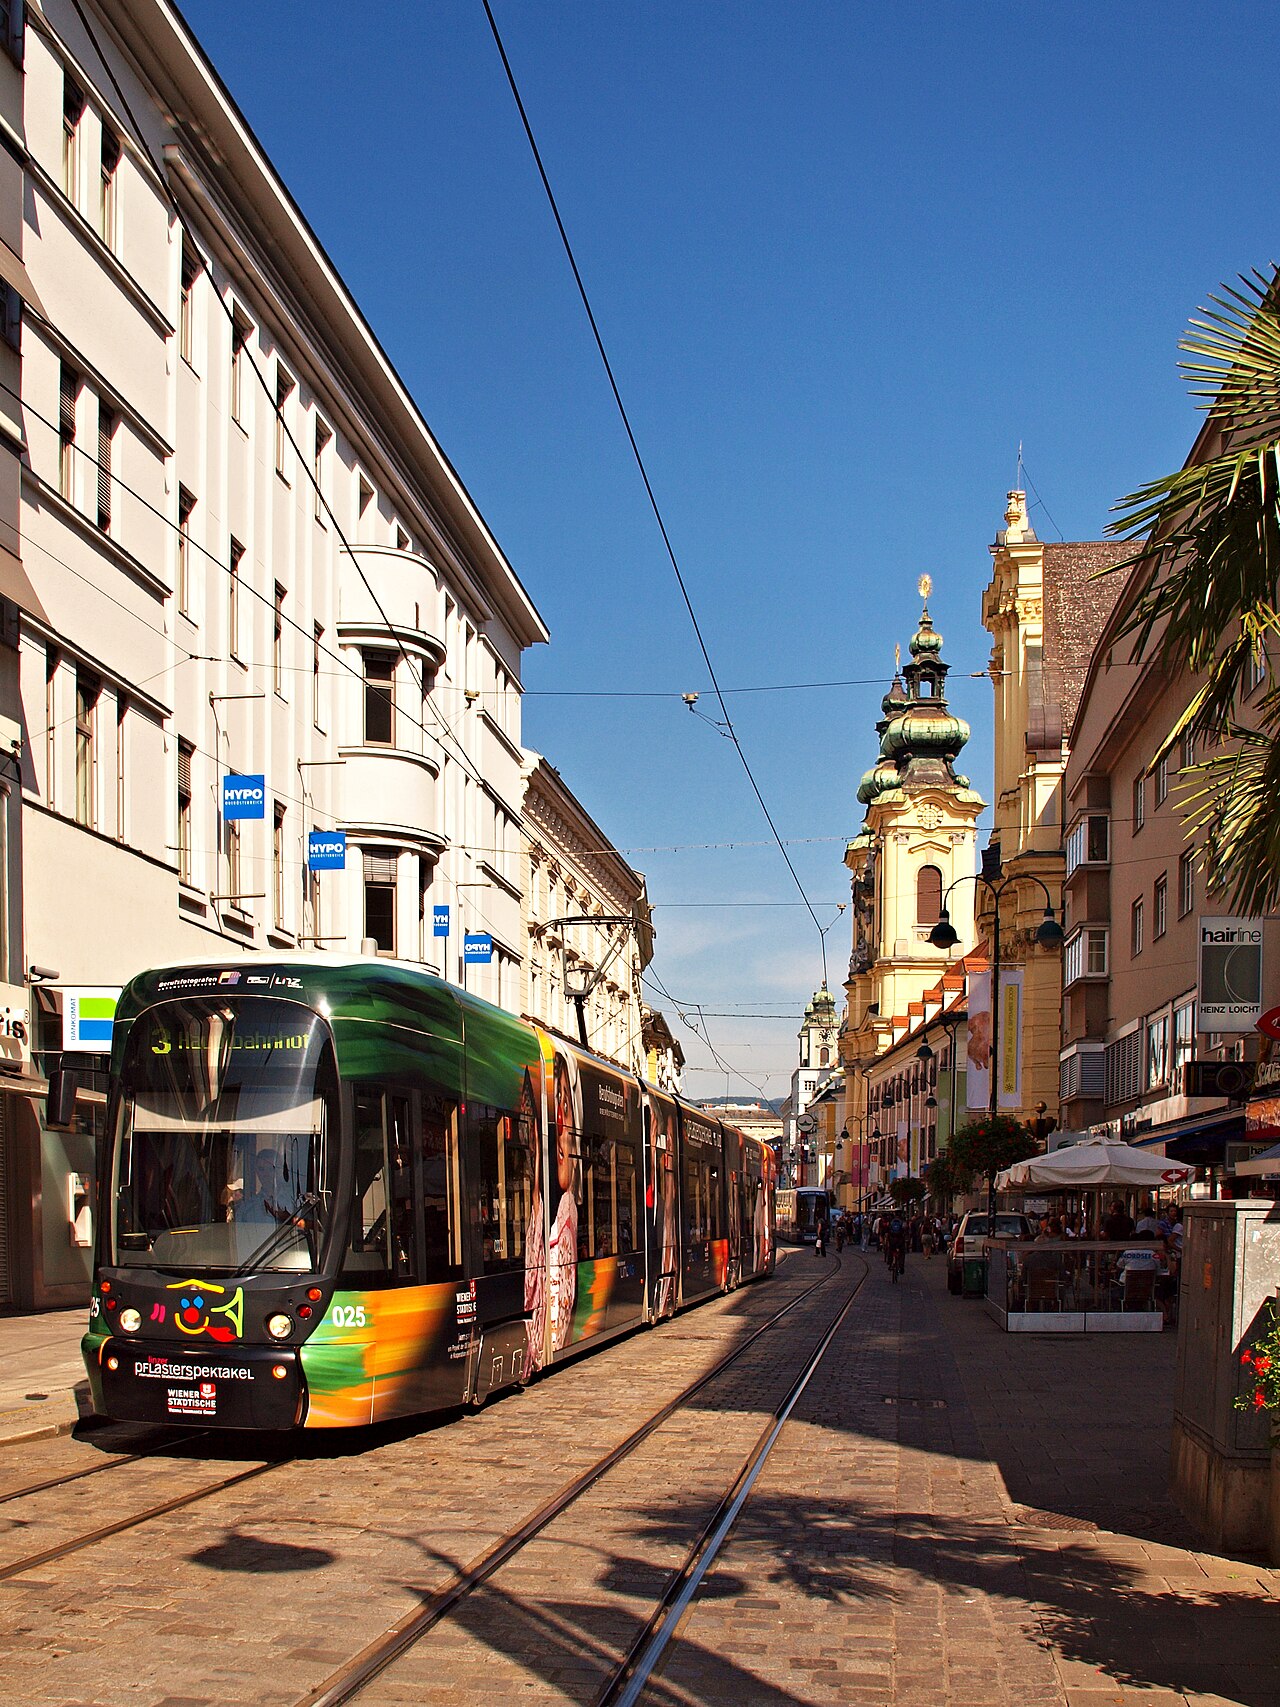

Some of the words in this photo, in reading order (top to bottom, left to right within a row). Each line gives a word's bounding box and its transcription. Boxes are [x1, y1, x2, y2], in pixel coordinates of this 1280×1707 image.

[224, 788, 263, 800] HYPO
[310, 843, 344, 853] HYPO
[1201, 927, 1261, 943] hairline
[1200, 1006, 1226, 1014] HEINZ
[1229, 1005, 1260, 1013] LOICHT
[151, 1027, 172, 1054] 3
[332, 1305, 366, 1328] 025
[147, 1355, 169, 1364] linzer
[167, 1388, 200, 1399] WIENER
[167, 1397, 217, 1409] STÄDTISCHE
